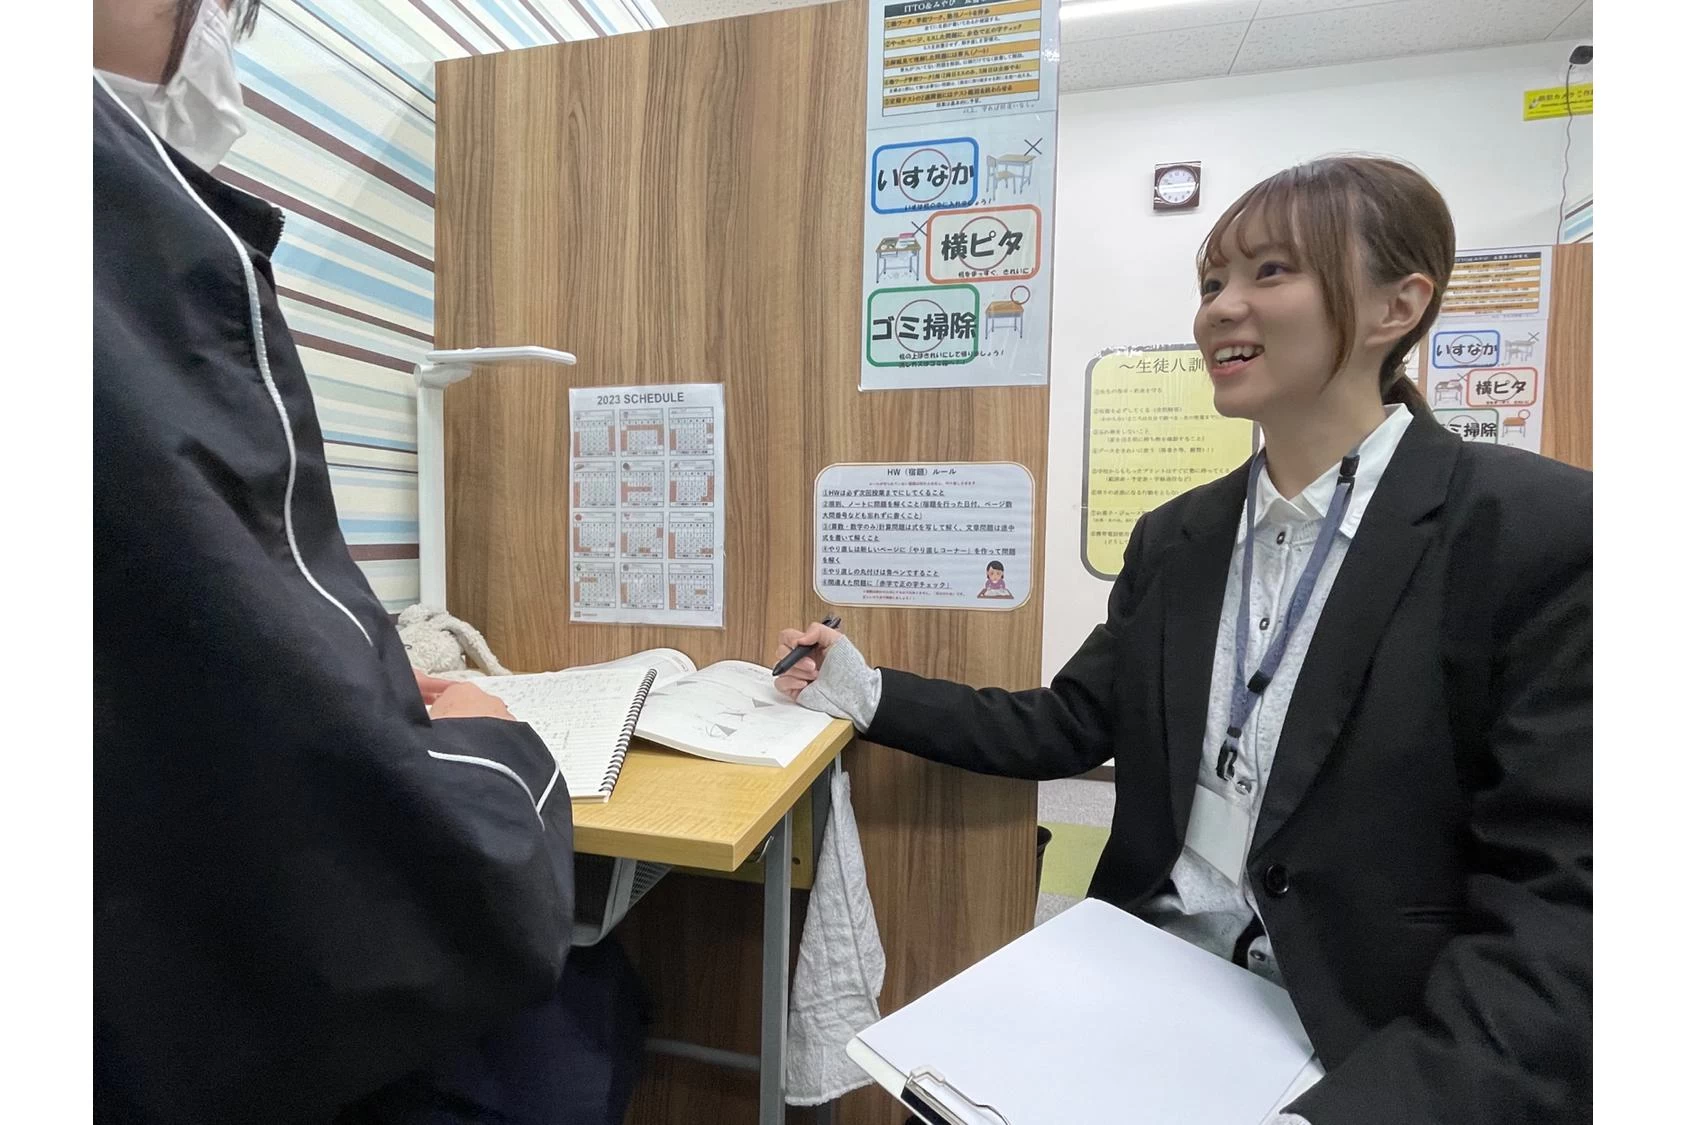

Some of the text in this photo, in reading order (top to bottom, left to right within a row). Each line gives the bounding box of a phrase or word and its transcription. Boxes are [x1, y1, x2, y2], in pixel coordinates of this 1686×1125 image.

[878, 162, 975, 191] いすなか
[941, 230, 1024, 261] 横ピタ
[872, 312, 977, 341] ゴミ掃除
[1436, 343, 1498, 357] いすなか
[1476, 380, 1527, 396] 横ピタ
[597, 391, 685, 405] 2023 SCHEDULE
[1440, 422, 1497, 438] ミ掃除
[822, 534, 881, 543] 式を書いて解くこと
[822, 556, 841, 565] を解く
